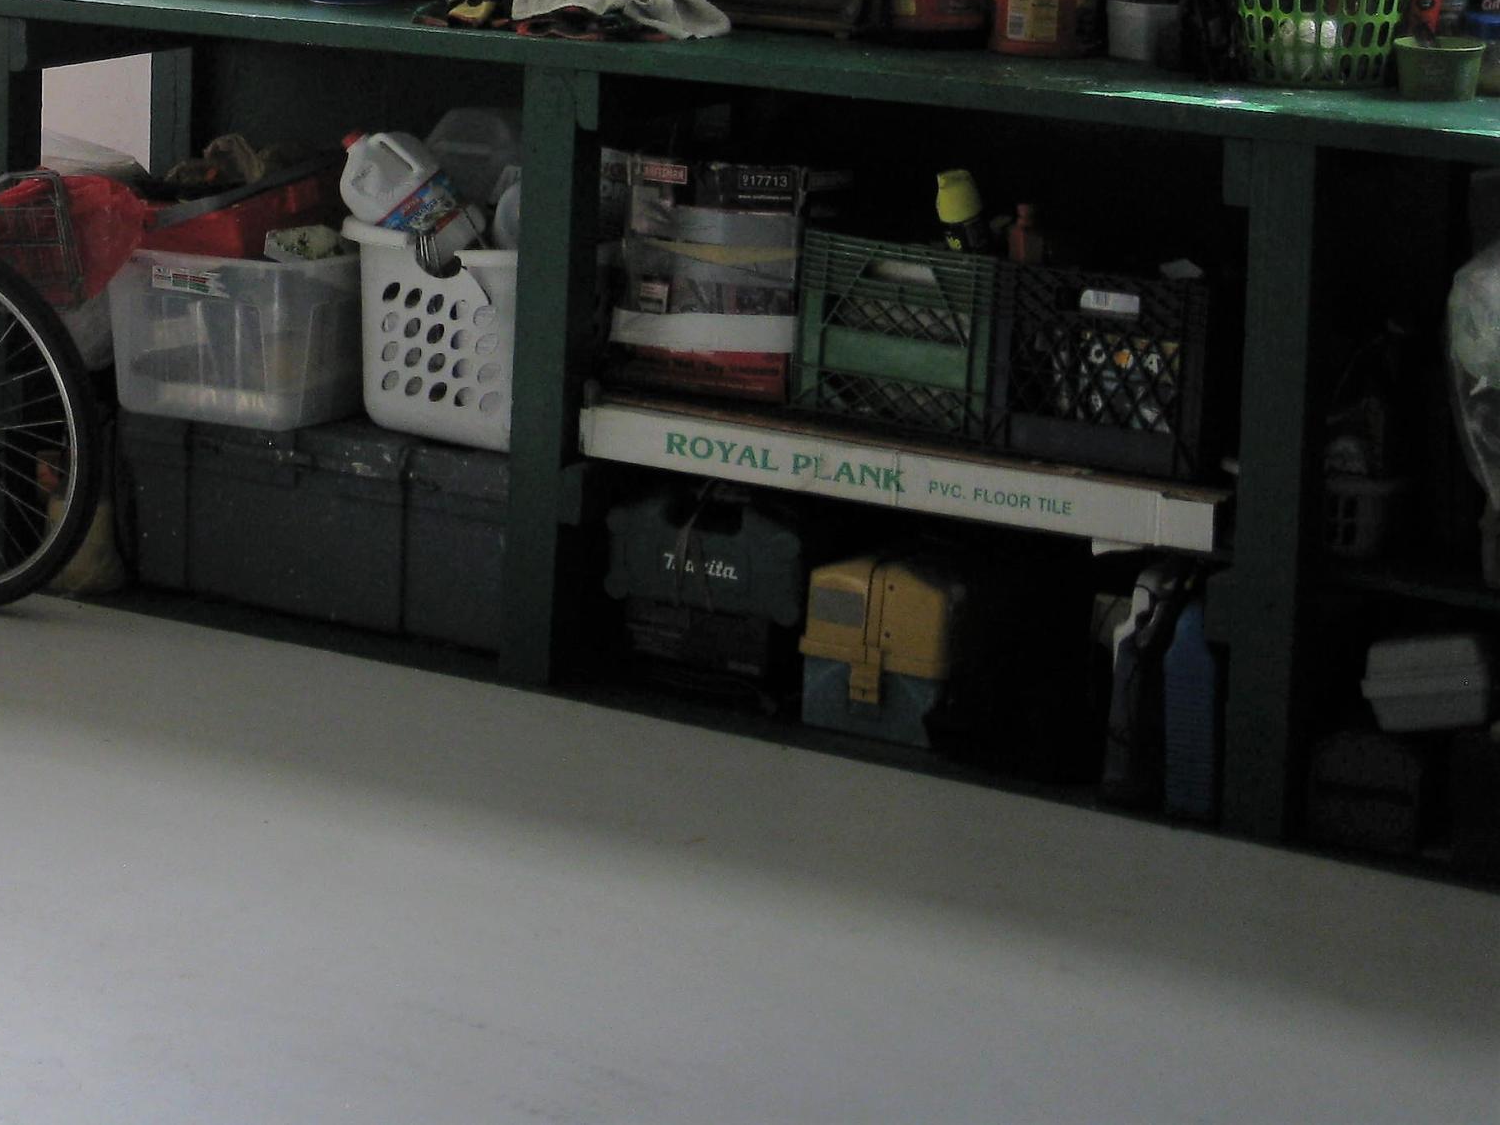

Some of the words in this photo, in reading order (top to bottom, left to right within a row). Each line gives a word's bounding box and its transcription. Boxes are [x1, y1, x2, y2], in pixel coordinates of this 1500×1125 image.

[665, 432, 779, 471] ROYAL
[791, 453, 906, 493] PLANK
[974, 487, 1030, 509] FLOOR
[1038, 497, 1072, 515] TILE
